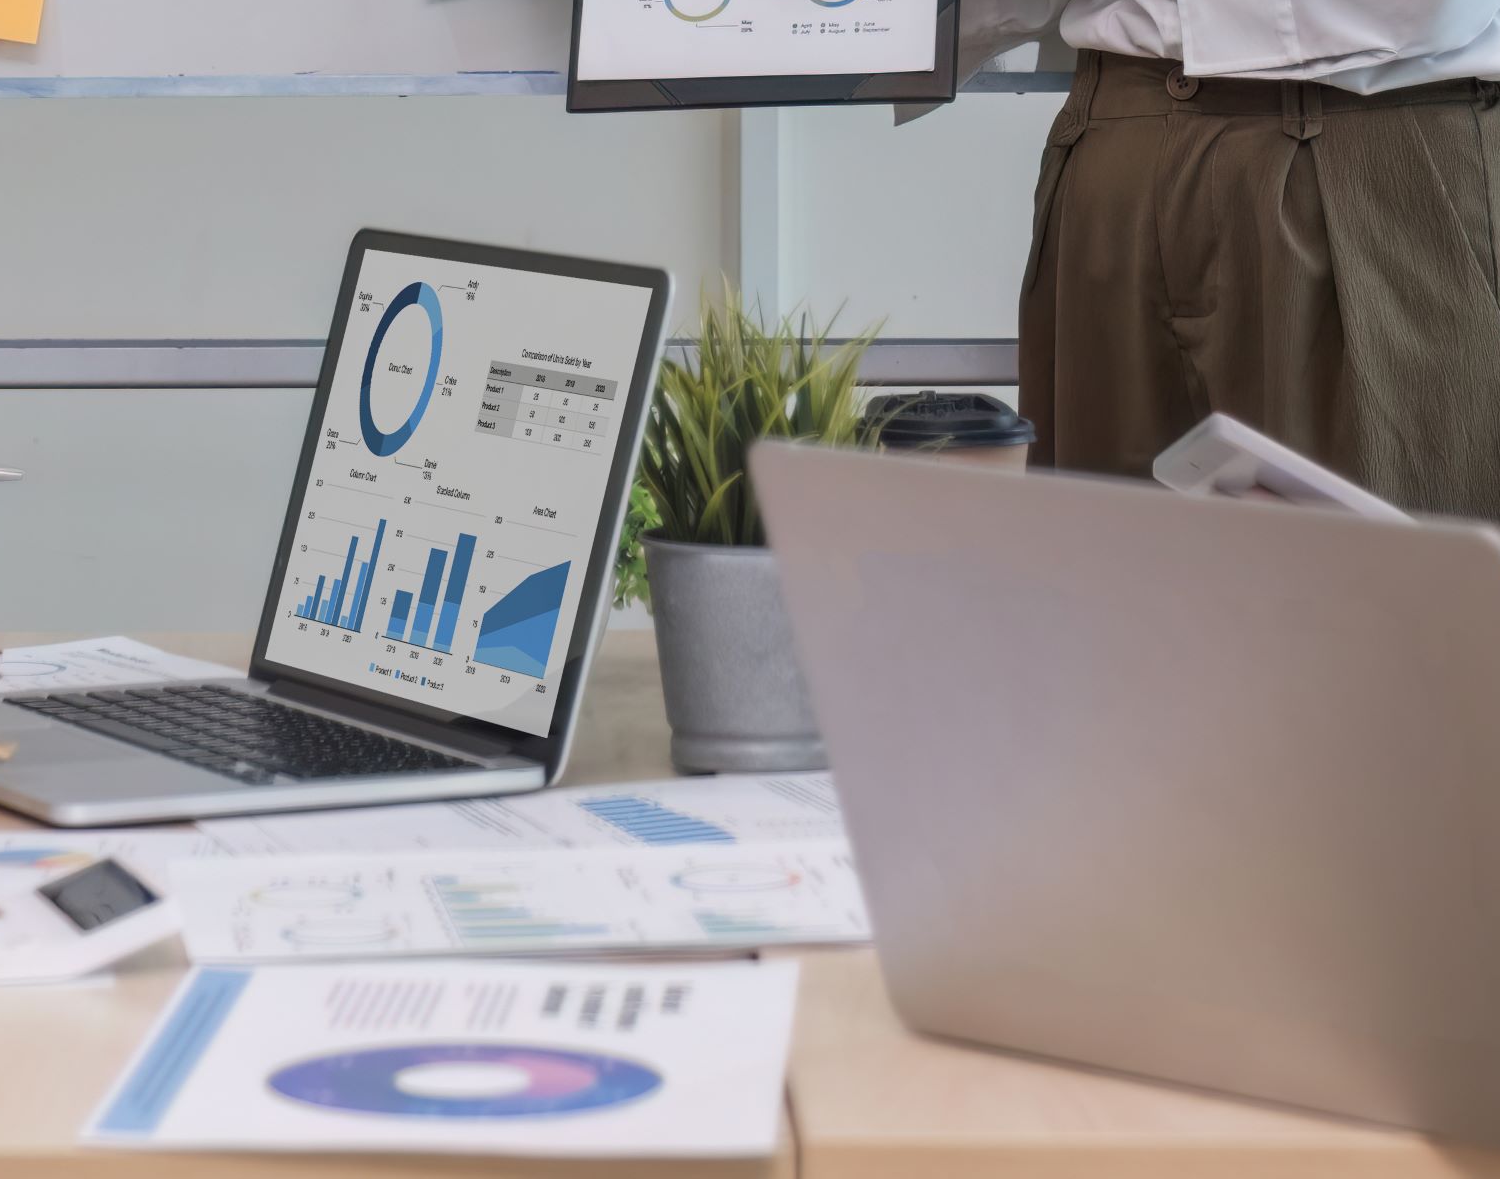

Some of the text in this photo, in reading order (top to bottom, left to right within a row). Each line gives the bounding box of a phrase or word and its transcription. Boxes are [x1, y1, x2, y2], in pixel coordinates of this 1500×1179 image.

[468, 279, 479, 291] Andy
[359, 291, 373, 302] Sophia
[521, 349, 548, 361] Comparison
[547, 352, 553, 361] of
[564, 355, 575, 365] Sold
[576, 357, 582, 368] by
[581, 358, 592, 369] Year
[489, 366, 512, 377] Description
[441, 387, 452, 397] 21%
[485, 383, 501, 394] Product
[481, 401, 496, 411] Product
[477, 419, 492, 429] Product
[436, 485, 471, 500] Stacked Column
[533, 505, 557, 519] Area Chart
